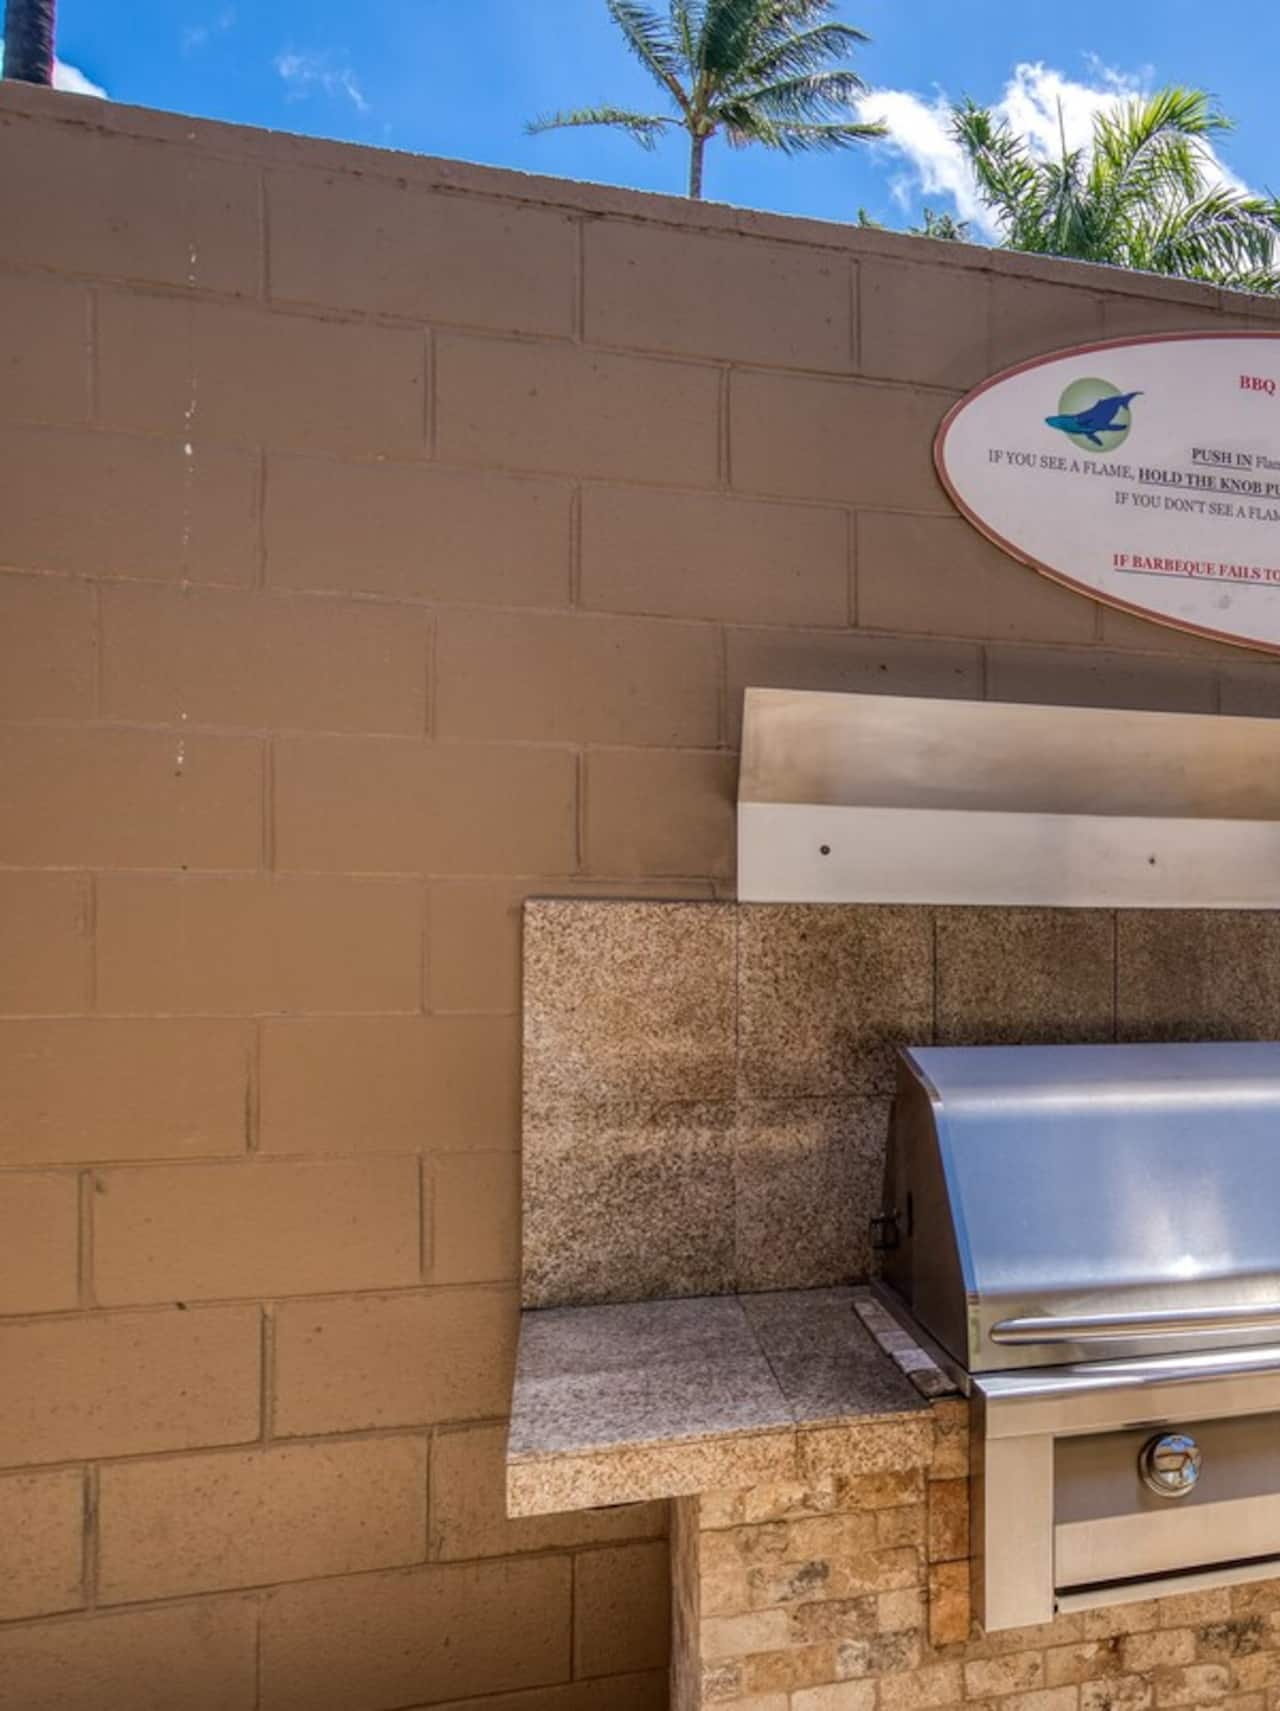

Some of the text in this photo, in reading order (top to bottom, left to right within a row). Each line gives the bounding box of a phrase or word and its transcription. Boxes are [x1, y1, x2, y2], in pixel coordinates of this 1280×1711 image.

[1239, 375, 1276, 396] BBQ
[1191, 448, 1232, 465] PUSH
[1236, 454, 1252, 466] IN
[988, 449, 1003, 463] IF
[1006, 452, 1037, 468] YOU
[1039, 455, 1068, 471] SEE
[1070, 459, 1080, 473] A
[1083, 460, 1136, 480] FLAME,
[1139, 467, 1182, 484] HOLD
[1184, 473, 1217, 488] THE
[1220, 477, 1263, 494] KNOB
[1115, 491, 1129, 505] IF
[1132, 493, 1162, 508] YOU
[1208, 502, 1234, 517] SEE
[1236, 505, 1247, 519] A
[1113, 554, 1130, 567] IF
[1132, 555, 1217, 576] BARBEQUE
[1219, 564, 1262, 580] FAILS
